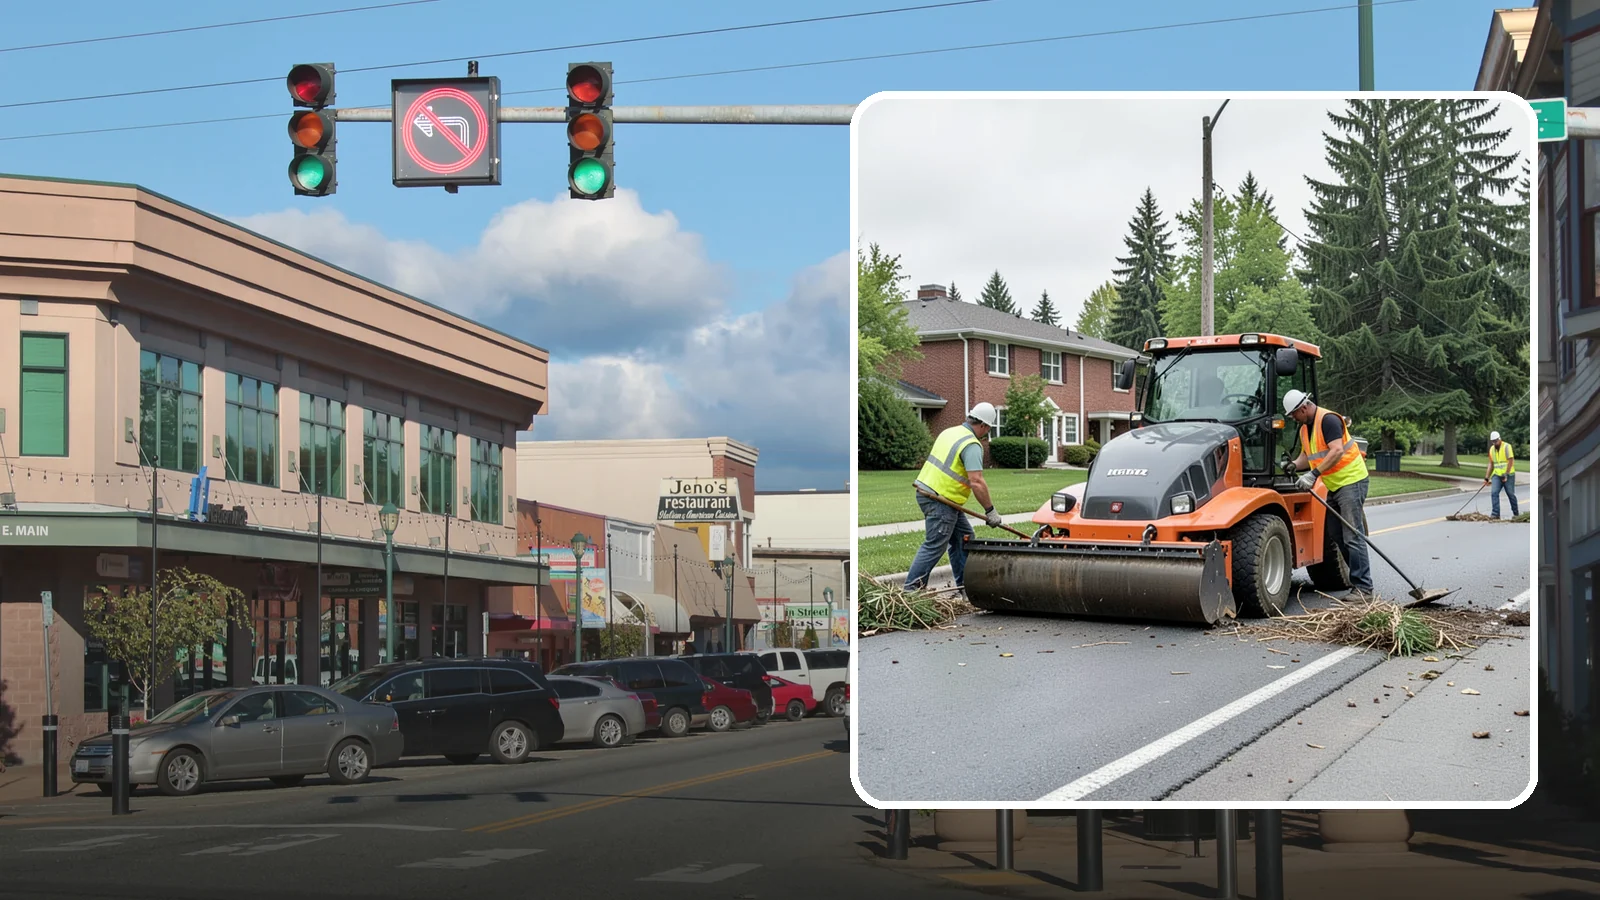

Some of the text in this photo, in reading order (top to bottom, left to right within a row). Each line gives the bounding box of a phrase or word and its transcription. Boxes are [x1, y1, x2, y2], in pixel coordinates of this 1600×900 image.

[669, 480, 728, 494] Jeno's
[665, 497, 731, 509] restaurant
[658, 510, 681, 519] Italian
[686, 509, 714, 519] American
[715, 509, 737, 519] Cuisine
[2, 525, 49, 536] E. MAIN
[785, 607, 828, 616] in Street
